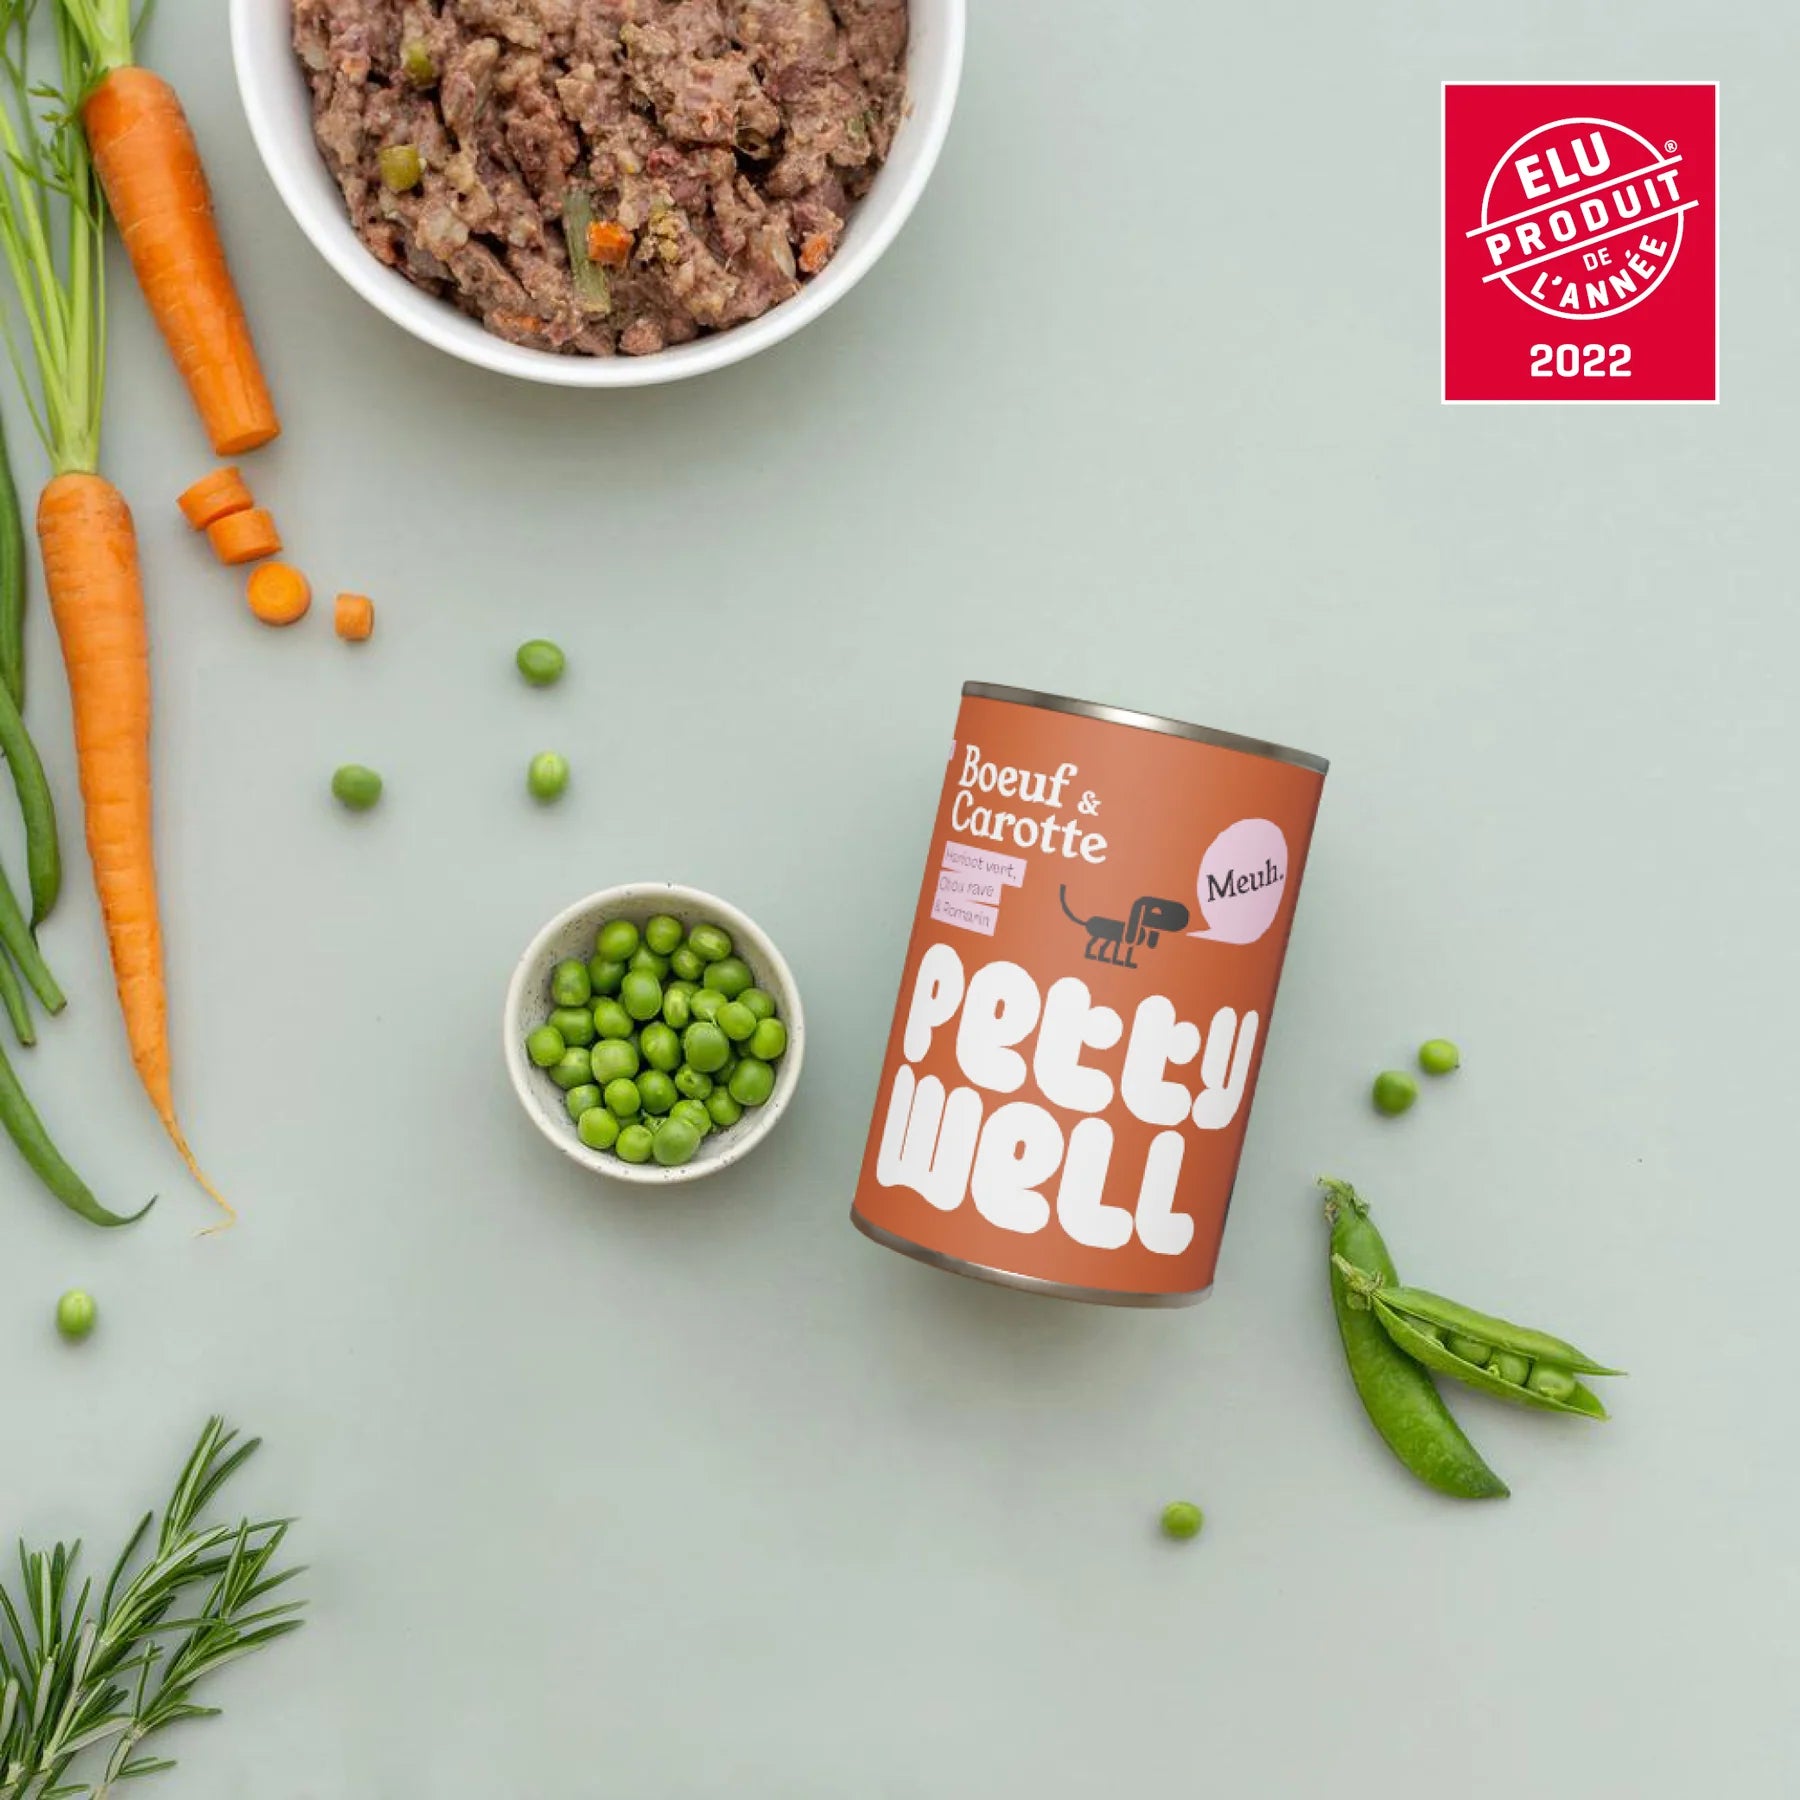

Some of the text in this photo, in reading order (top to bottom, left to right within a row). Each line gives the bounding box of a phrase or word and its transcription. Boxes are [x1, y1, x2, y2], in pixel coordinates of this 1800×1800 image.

[958, 744, 1101, 816] Boeuf &
[952, 789, 1108, 864] Carotte
[1207, 859, 1285, 902] Meuh.
